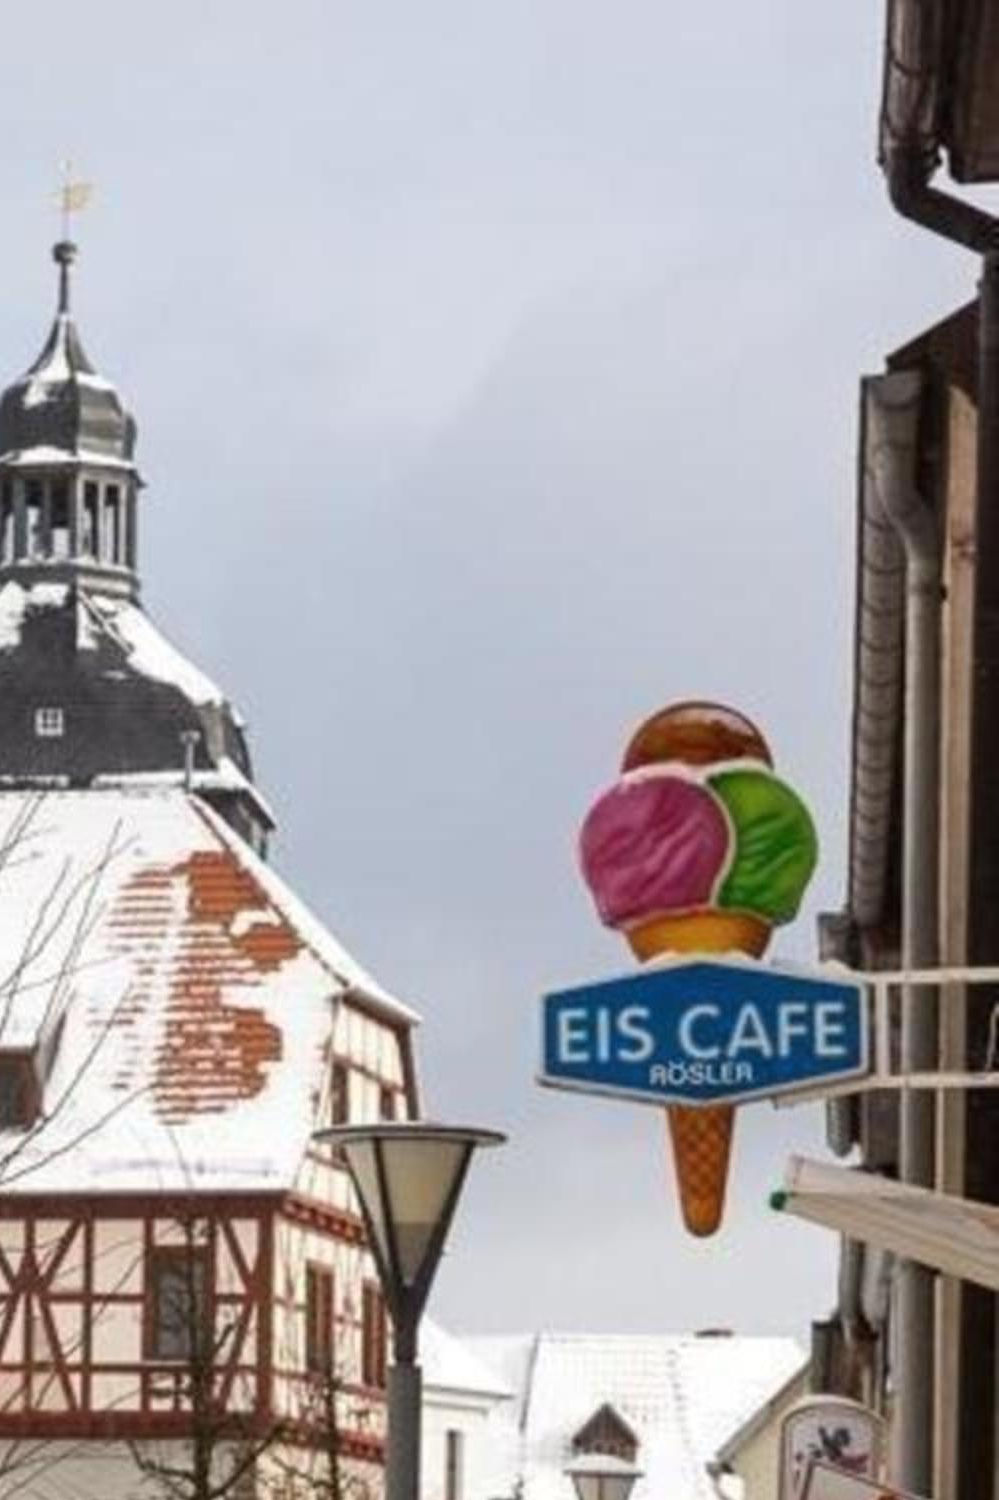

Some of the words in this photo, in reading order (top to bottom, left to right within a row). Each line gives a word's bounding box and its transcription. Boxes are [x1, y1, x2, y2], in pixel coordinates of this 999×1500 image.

[557, 1005, 656, 1064] EIS
[677, 1001, 851, 1060] CAFE
[649, 1060, 753, 1087] RÖSLER
